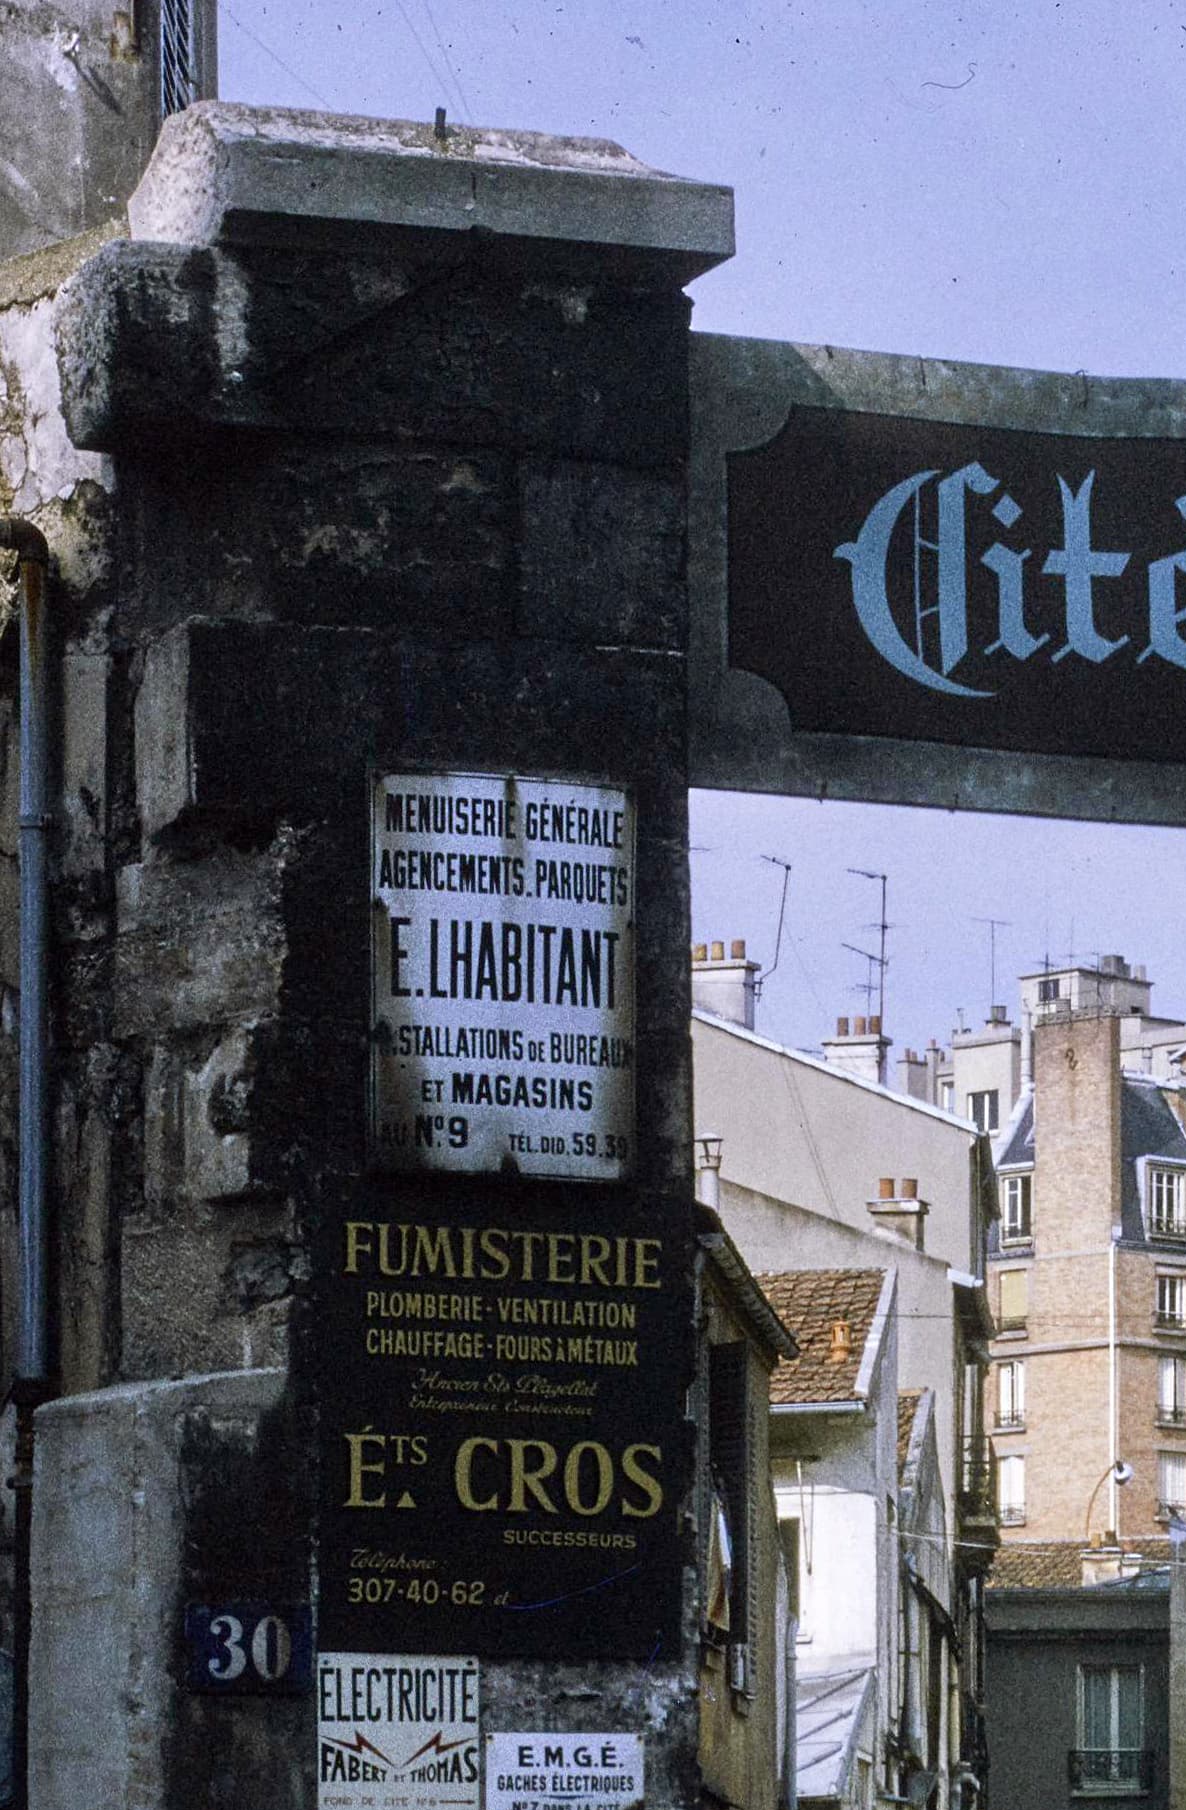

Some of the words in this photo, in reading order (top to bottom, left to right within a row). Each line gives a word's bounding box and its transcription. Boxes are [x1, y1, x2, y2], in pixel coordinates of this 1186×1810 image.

[386, 793, 516, 839] MENUISERIE
[526, 798, 624, 849] GÉNÉRALE
[382, 1025, 524, 1061] STALLATIONS
[528, 1040, 545, 1063] DE
[421, 1080, 444, 1103] ET
[452, 1073, 593, 1112] MAGASINS
[343, 1222, 662, 1289] FUMISTERIE
[367, 1292, 482, 1322] PLOMBERIE
[497, 1298, 636, 1329] VENTILATION
[366, 1328, 484, 1359] CHAUFFAGE
[497, 1334, 552, 1361] FOURS
[567, 1338, 638, 1366] MÉTAUX
[454, 1436, 664, 1518] CROS
[503, 1529, 637, 1549] SUCCESSEURS
[208, 1615, 291, 1680] 30
[321, 1743, 387, 1782] FABERT
[410, 1747, 478, 1783] THOMAS
[497, 1775, 546, 1791] GACHES
[552, 1772, 634, 1793] ÉLECTRIQUES
